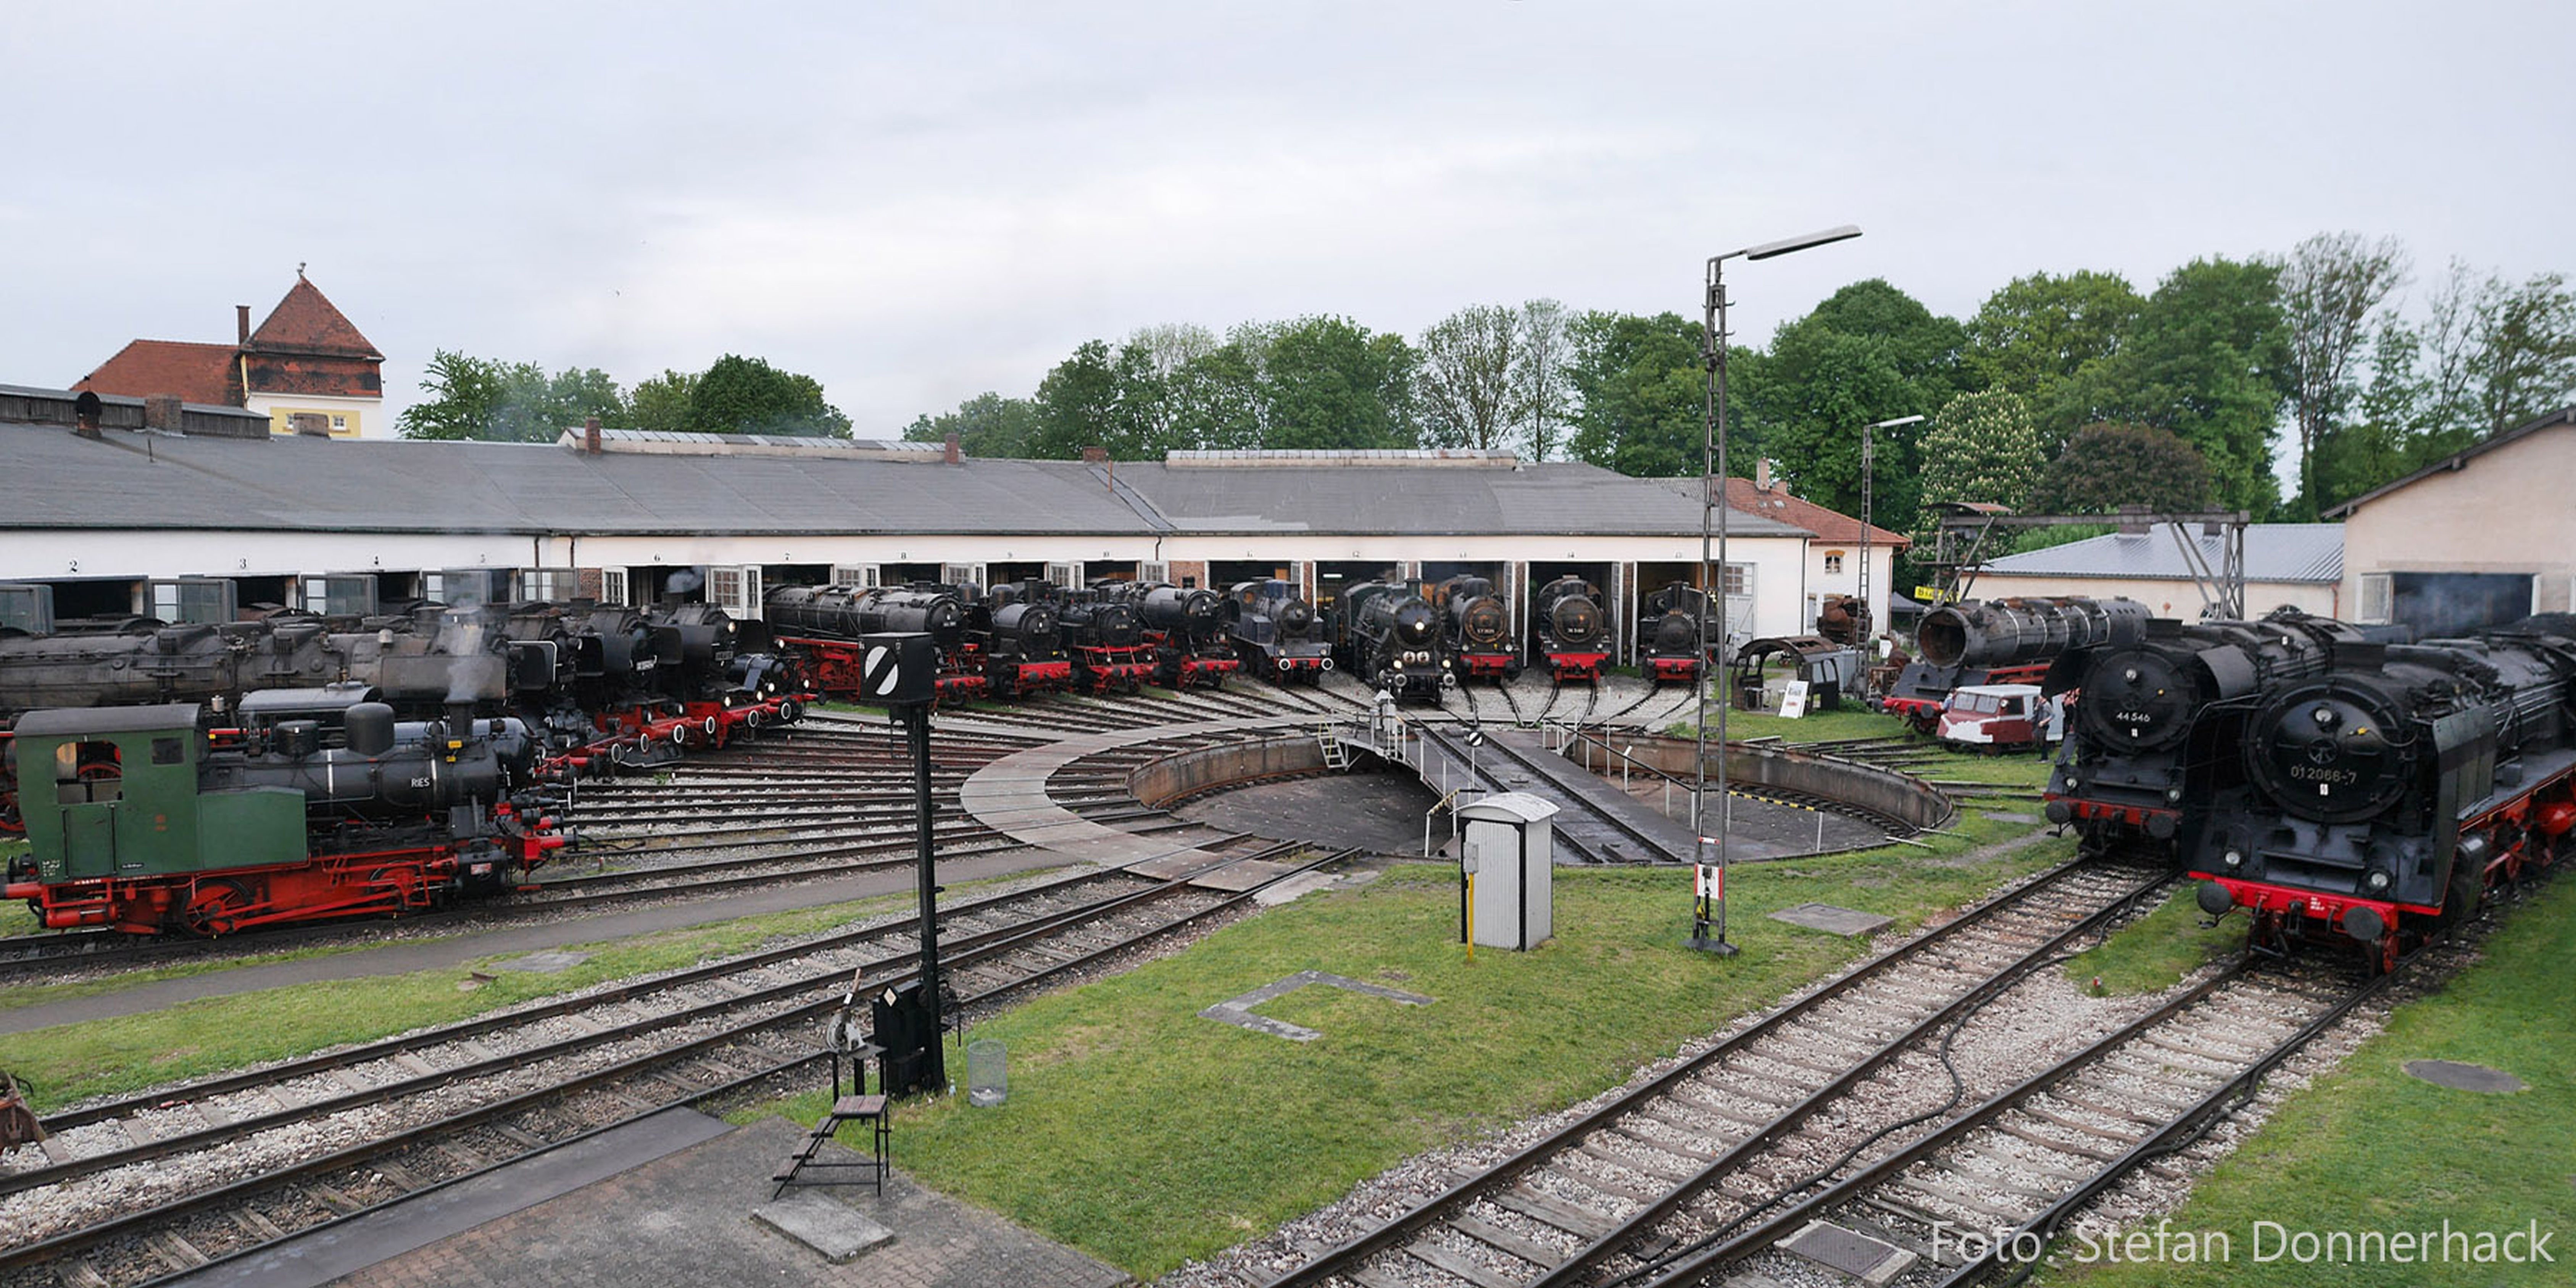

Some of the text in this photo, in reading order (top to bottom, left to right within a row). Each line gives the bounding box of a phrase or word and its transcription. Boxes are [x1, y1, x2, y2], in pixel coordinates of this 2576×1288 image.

[654, 553, 661, 561] 6
[785, 552, 790, 561] 7
[900, 552, 907, 560] 8
[69, 560, 78, 573] 2
[239, 558, 247, 569] 3
[2117, 712, 2151, 722] 44 546
[411, 777, 430, 787] RIES
